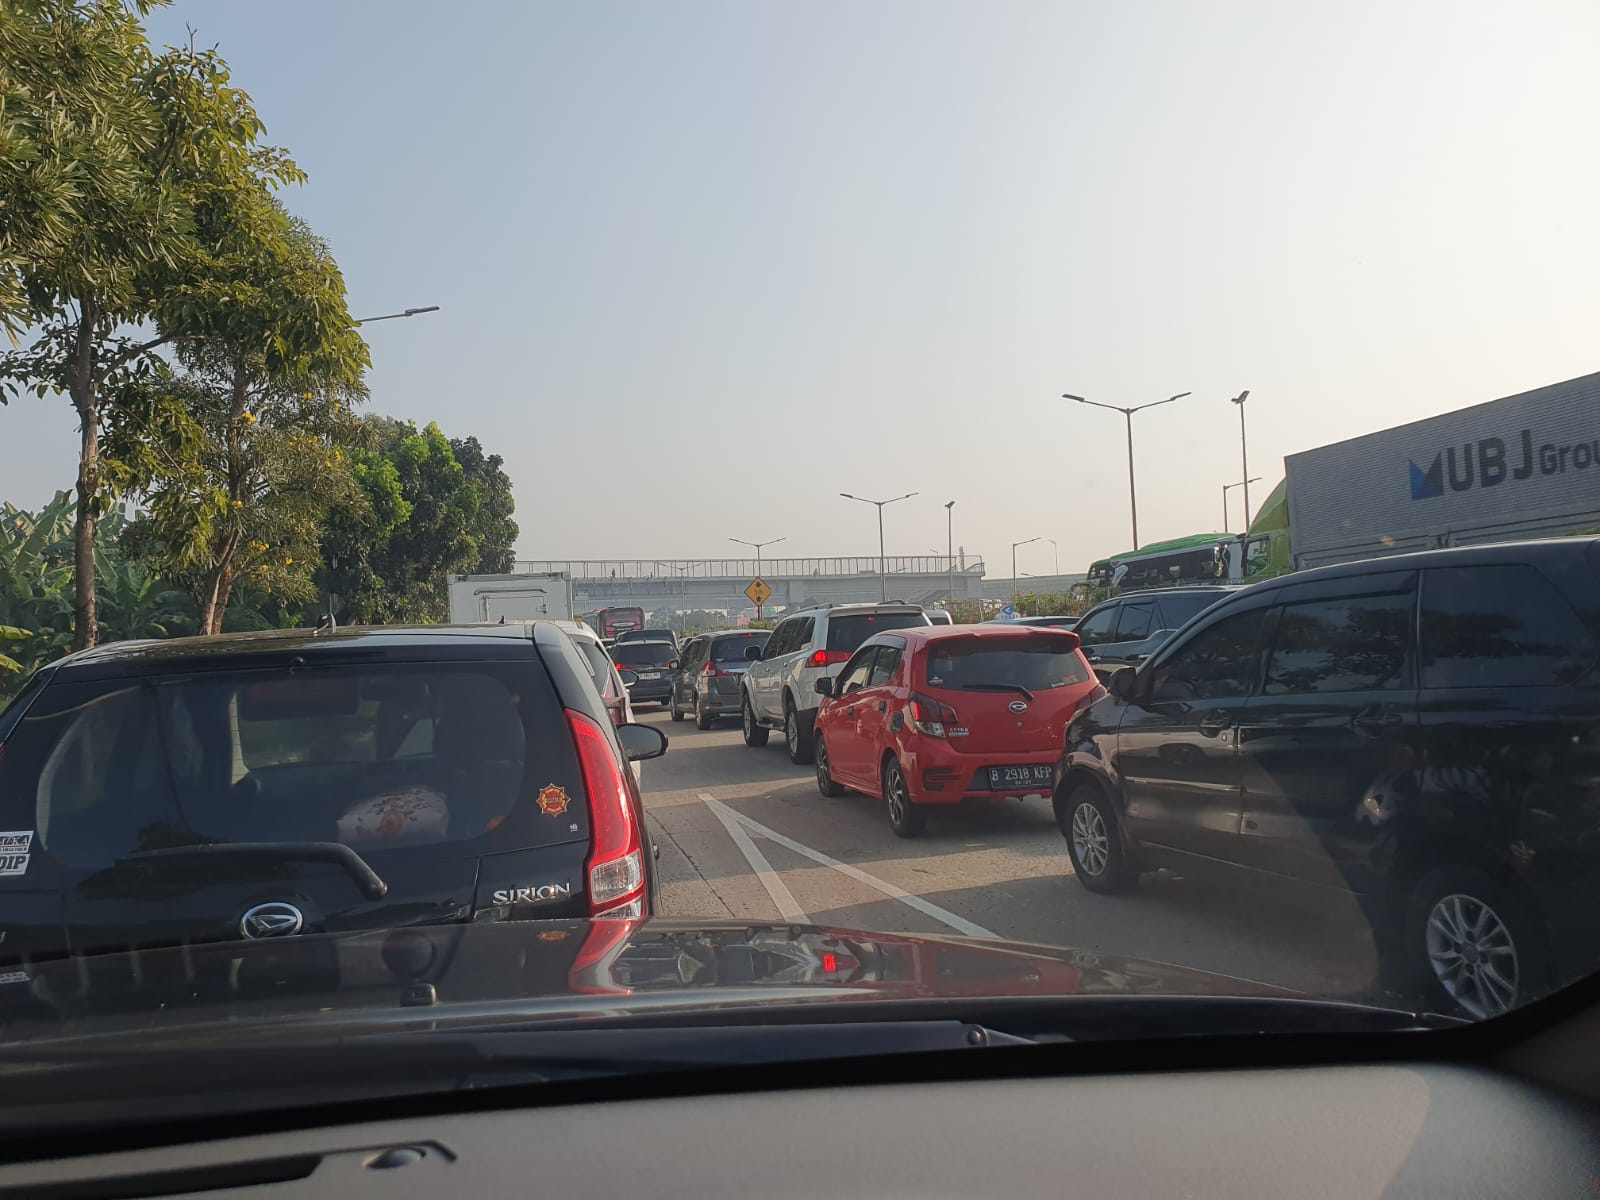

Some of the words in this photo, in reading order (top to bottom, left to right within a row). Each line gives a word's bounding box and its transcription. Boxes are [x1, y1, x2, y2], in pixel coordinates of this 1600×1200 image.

[991, 769, 999, 781] B
[1005, 767, 1030, 780] 2918
[492, 882, 570, 905] SIRION
